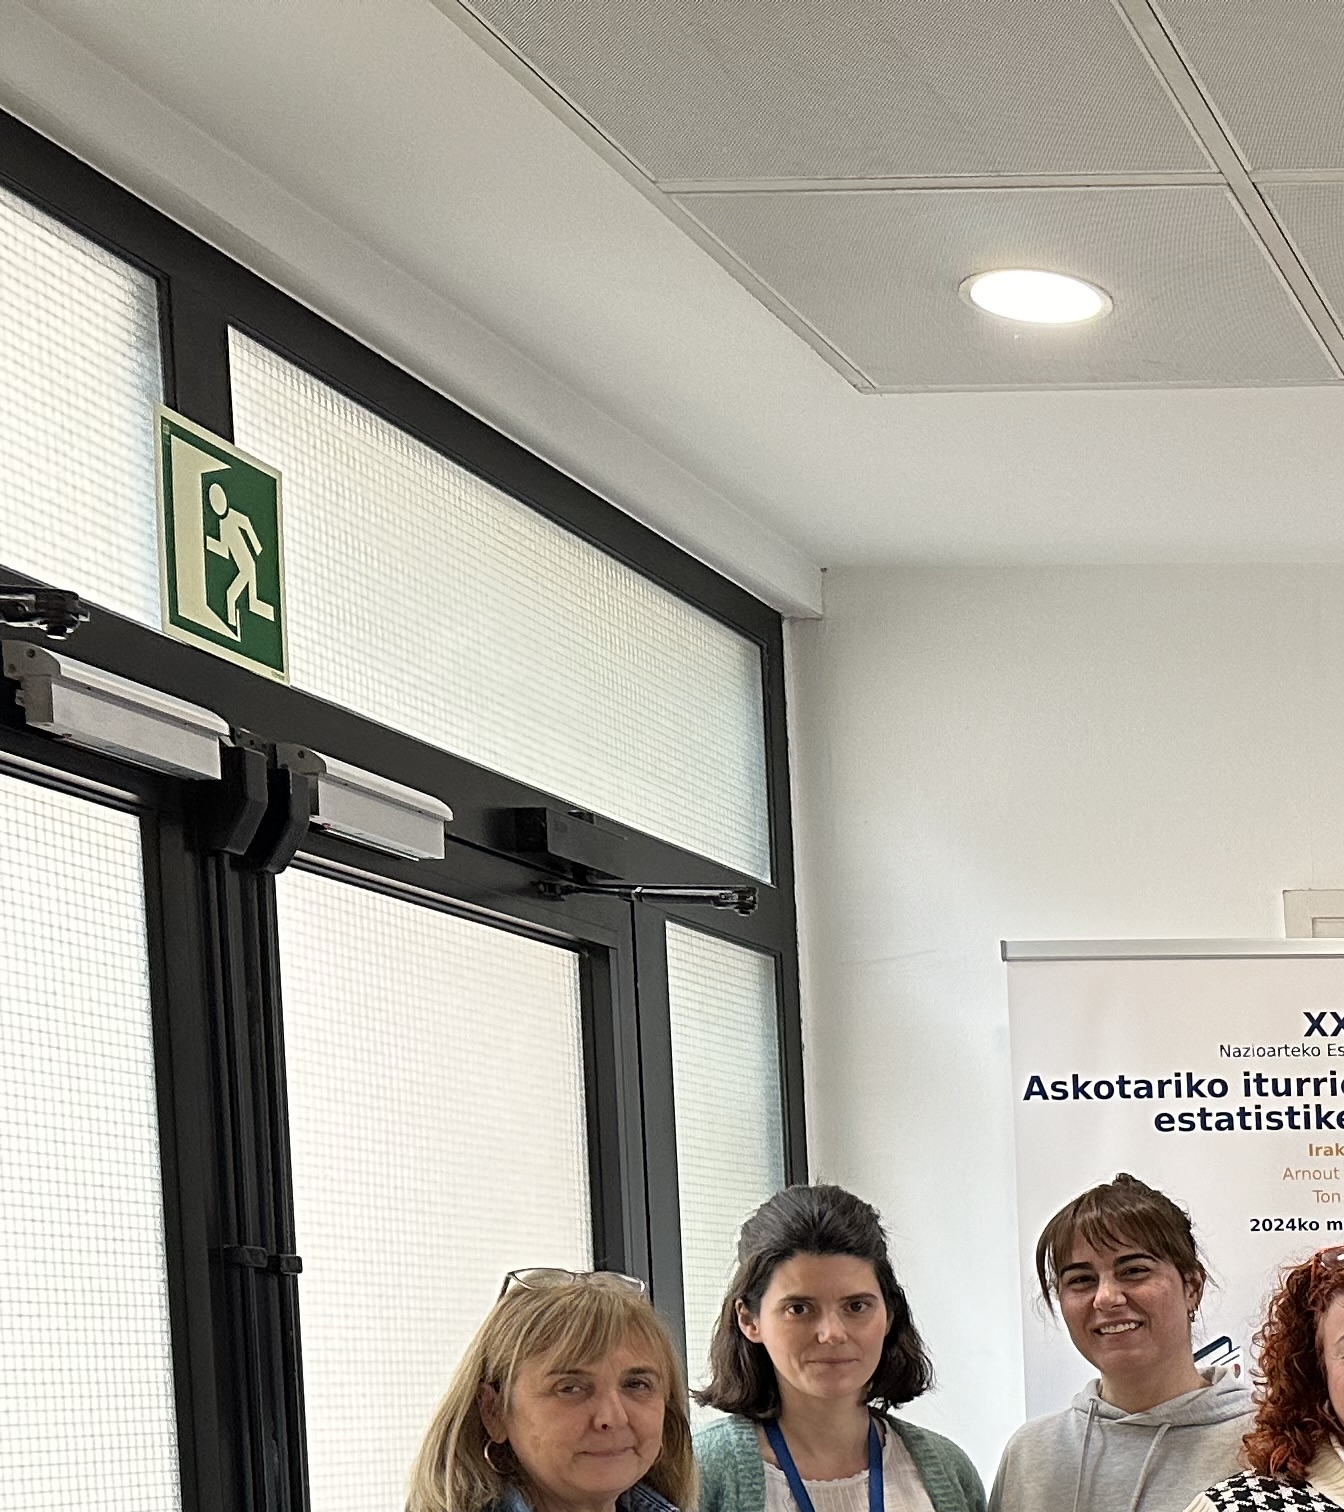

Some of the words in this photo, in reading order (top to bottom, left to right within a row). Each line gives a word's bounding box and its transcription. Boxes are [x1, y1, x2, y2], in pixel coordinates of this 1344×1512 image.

[1219, 1042, 1322, 1058] Nazioarteko
[1022, 1071, 1229, 1102] Askotariko
[1282, 1166, 1341, 1181] Arnout
[1311, 1189, 1342, 1204] Ton
[1249, 1216, 1320, 1232] 2024ko
